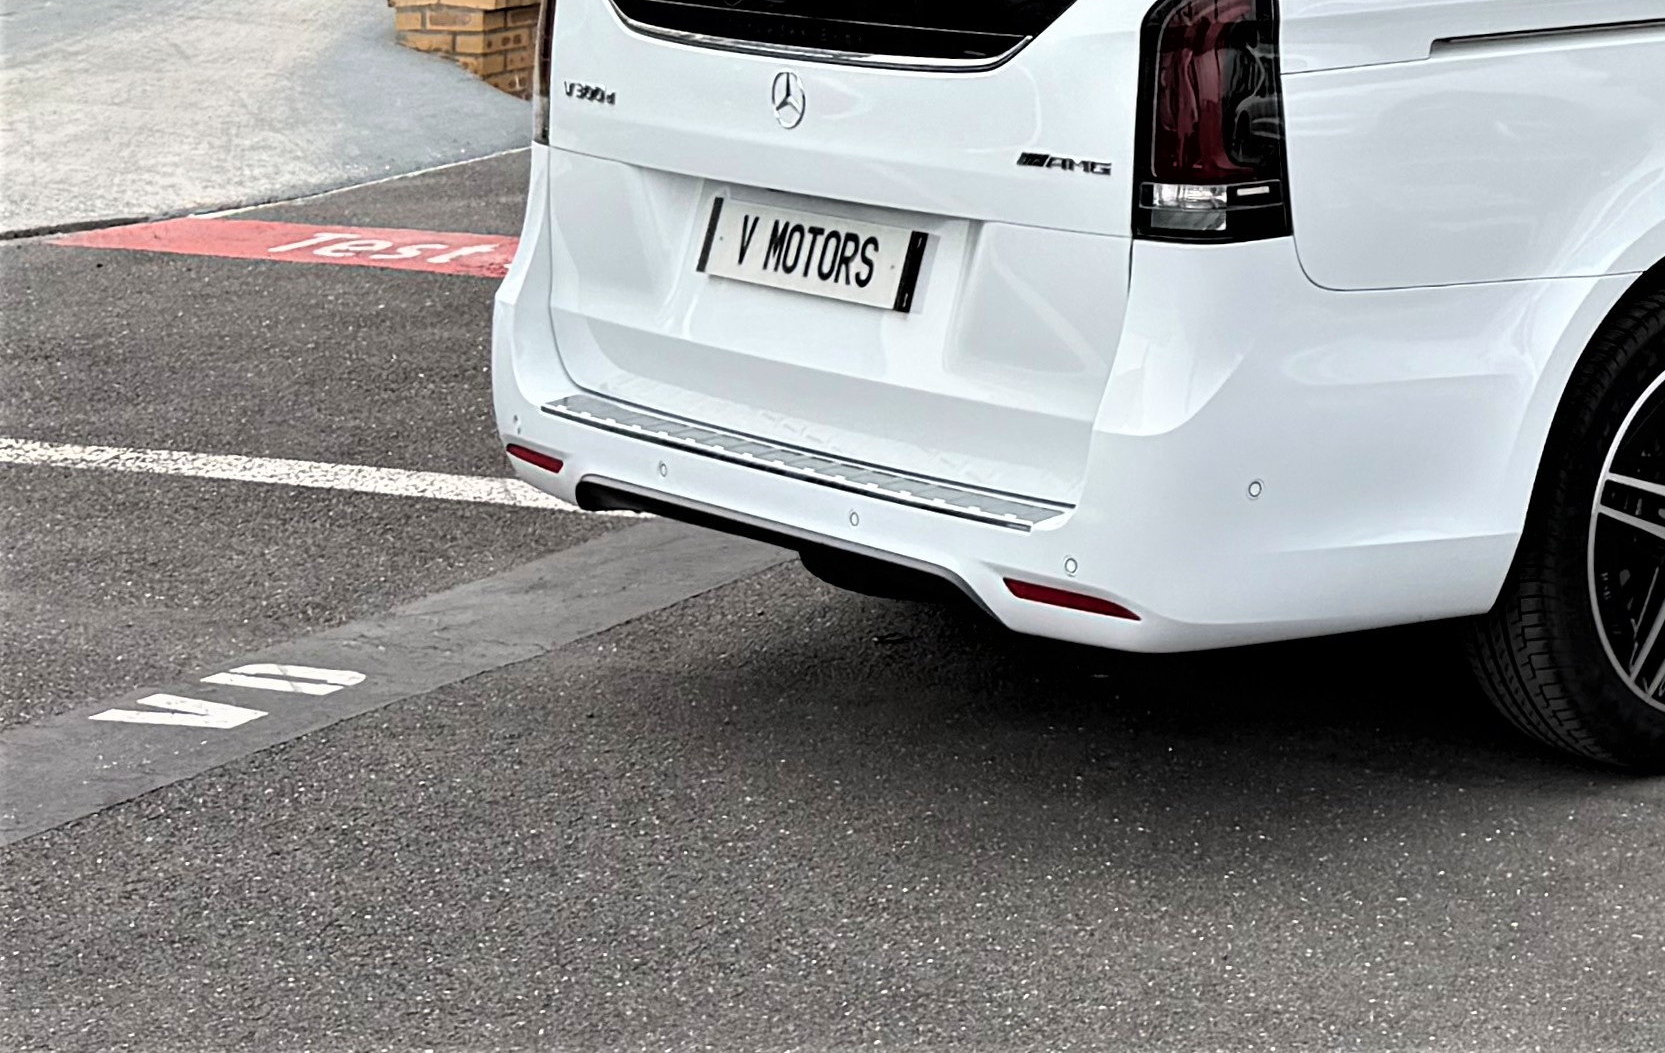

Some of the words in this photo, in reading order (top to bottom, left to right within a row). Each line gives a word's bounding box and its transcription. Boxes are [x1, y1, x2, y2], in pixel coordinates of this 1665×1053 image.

[1044, 155, 1112, 176] AMG
[267, 232, 500, 264] Test
[738, 214, 760, 266] V
[763, 218, 880, 288] MOTORS
